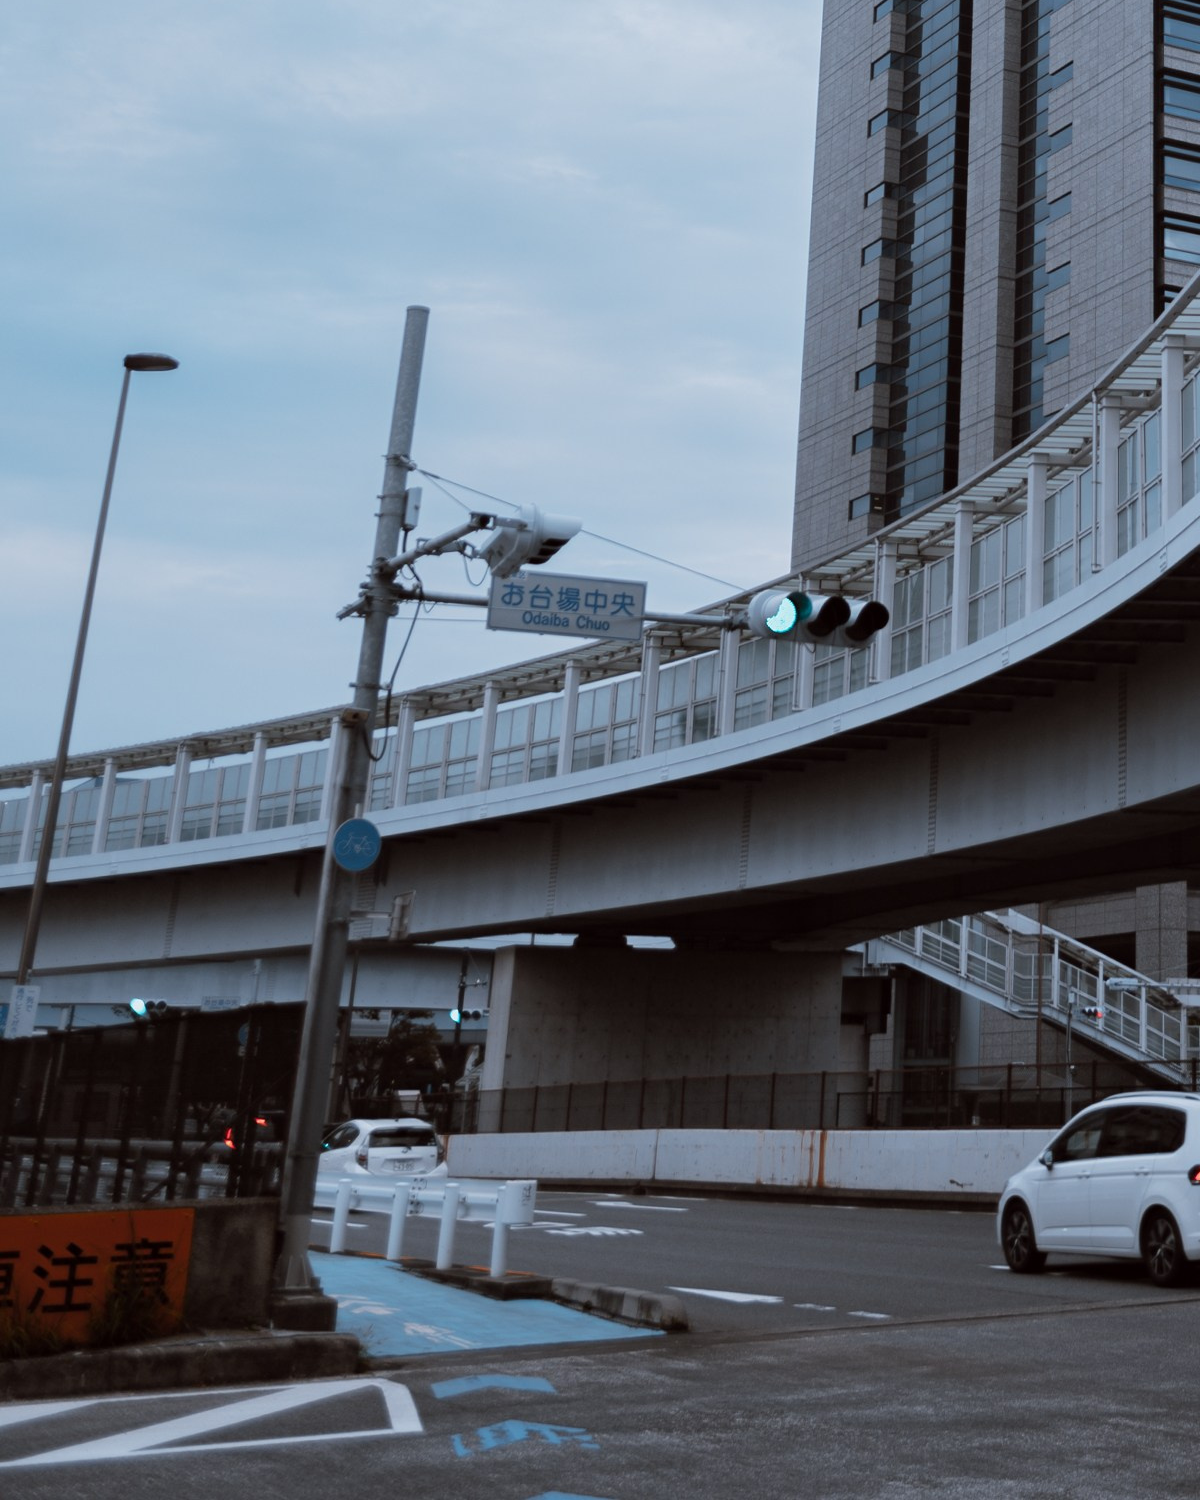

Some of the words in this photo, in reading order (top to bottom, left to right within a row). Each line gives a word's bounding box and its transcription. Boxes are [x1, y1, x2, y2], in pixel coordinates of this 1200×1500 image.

[501, 583, 635, 617] お台場中央
[522, 610, 570, 627] Odaiba
[576, 615, 610, 631] Chuo
[0, 1238, 174, 1313] 注意
